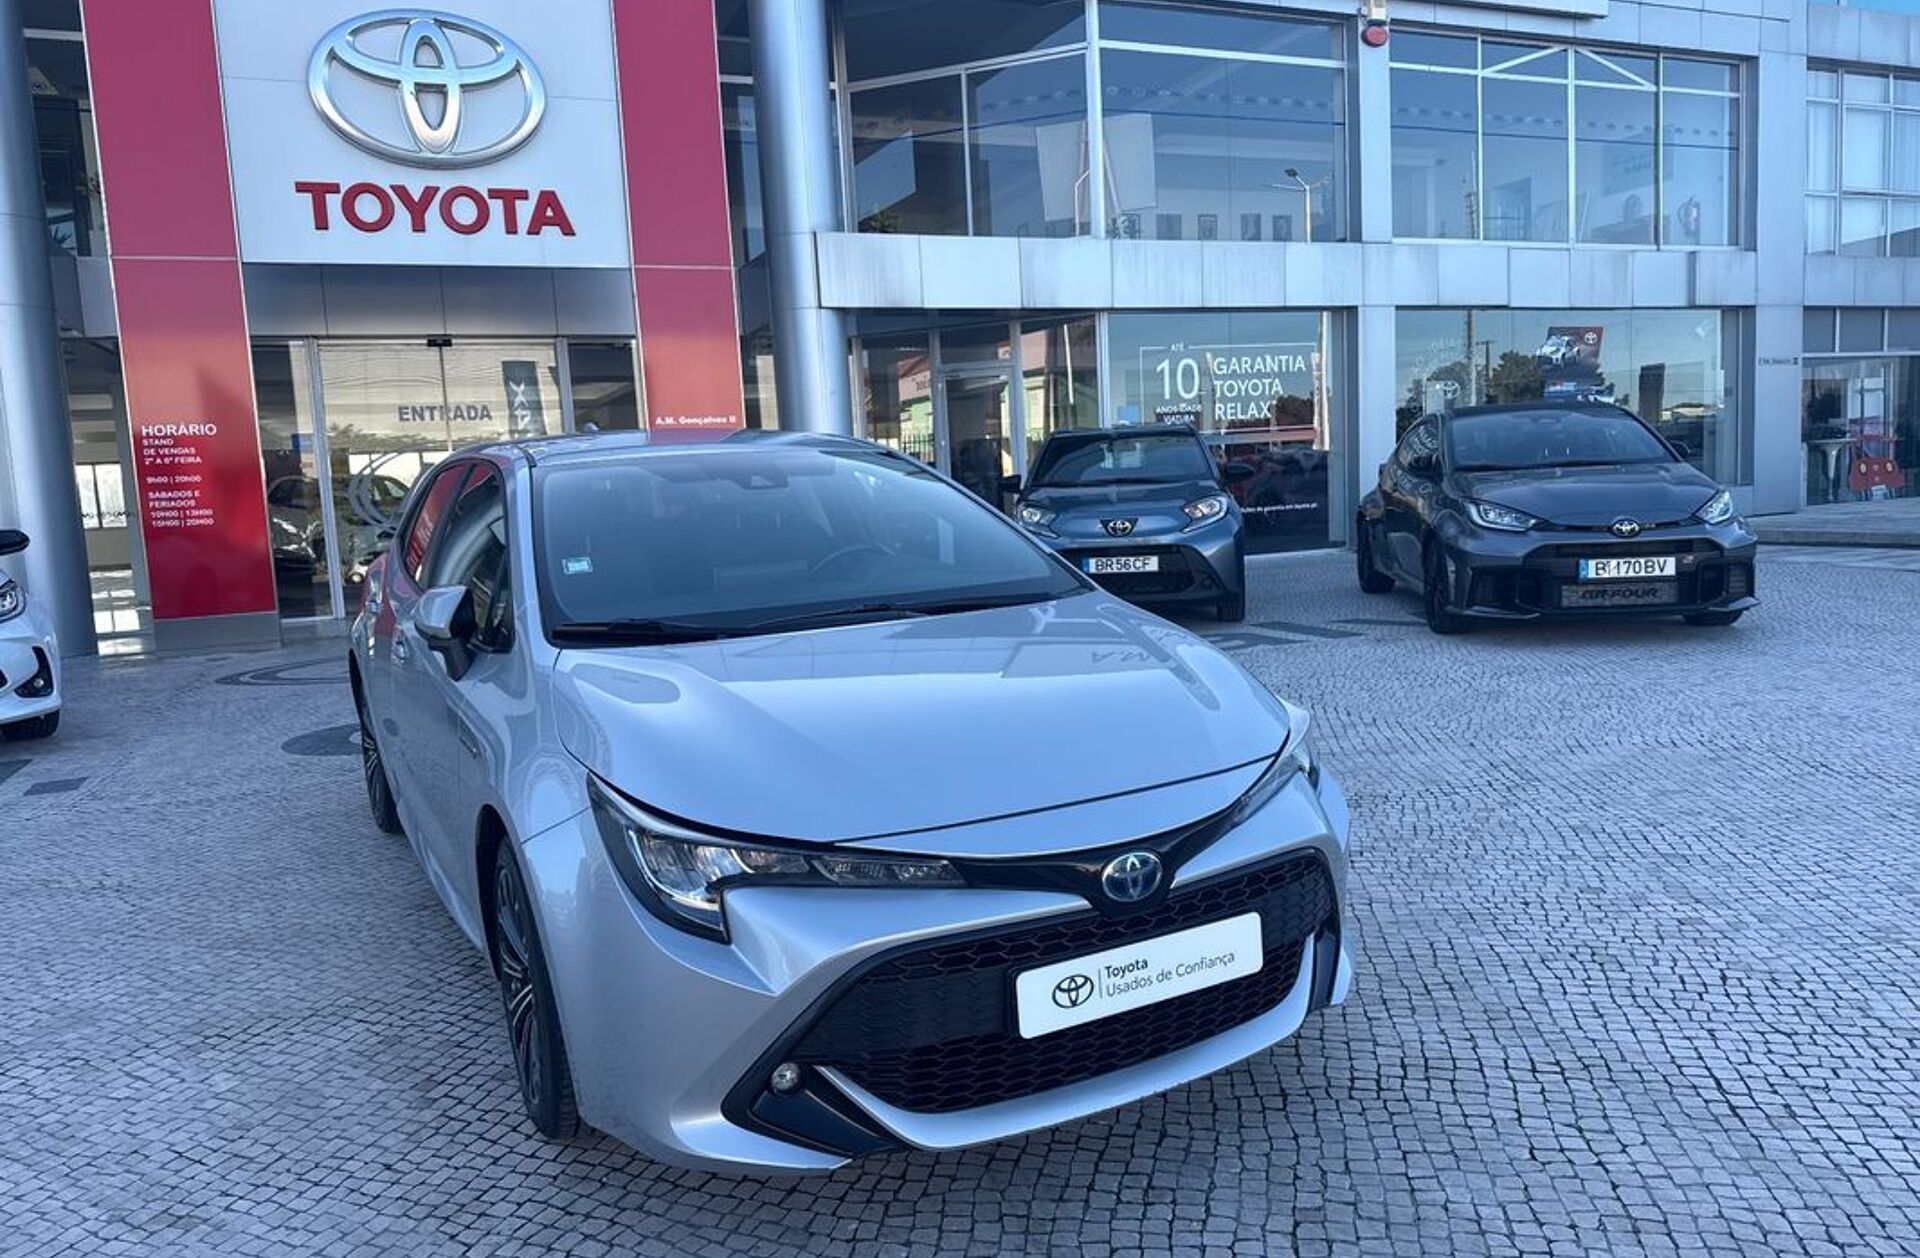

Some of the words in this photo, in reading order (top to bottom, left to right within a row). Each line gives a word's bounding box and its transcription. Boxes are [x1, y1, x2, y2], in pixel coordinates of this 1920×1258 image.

[295, 181, 576, 236] TOYOTA
[1170, 342, 1185, 352] ATÉ
[1213, 355, 1306, 375] GARANTIA
[1155, 357, 1200, 400] 10
[1213, 378, 1284, 398] TOYOTA
[397, 404, 493, 422] ENTRADA
[1214, 402, 1272, 421] RELAX
[141, 420, 217, 437] HORÁRIO
[655, 416, 678, 425] A.M.
[142, 438, 174, 447] STAND
[143, 448, 156, 456] DE
[158, 447, 196, 455] VENDAS
[155, 457, 163, 465] A
[174, 456, 203, 464] FEIRA
[194, 489, 201, 497] E
[149, 499, 196, 509] FERIADOS
[1094, 557, 1151, 572] BR56CF
[1104, 958, 1149, 979] Toyota
[1105, 975, 1153, 998] Usados
[1156, 968, 1173, 983] de
[1175, 952, 1235, 978] Confiança
